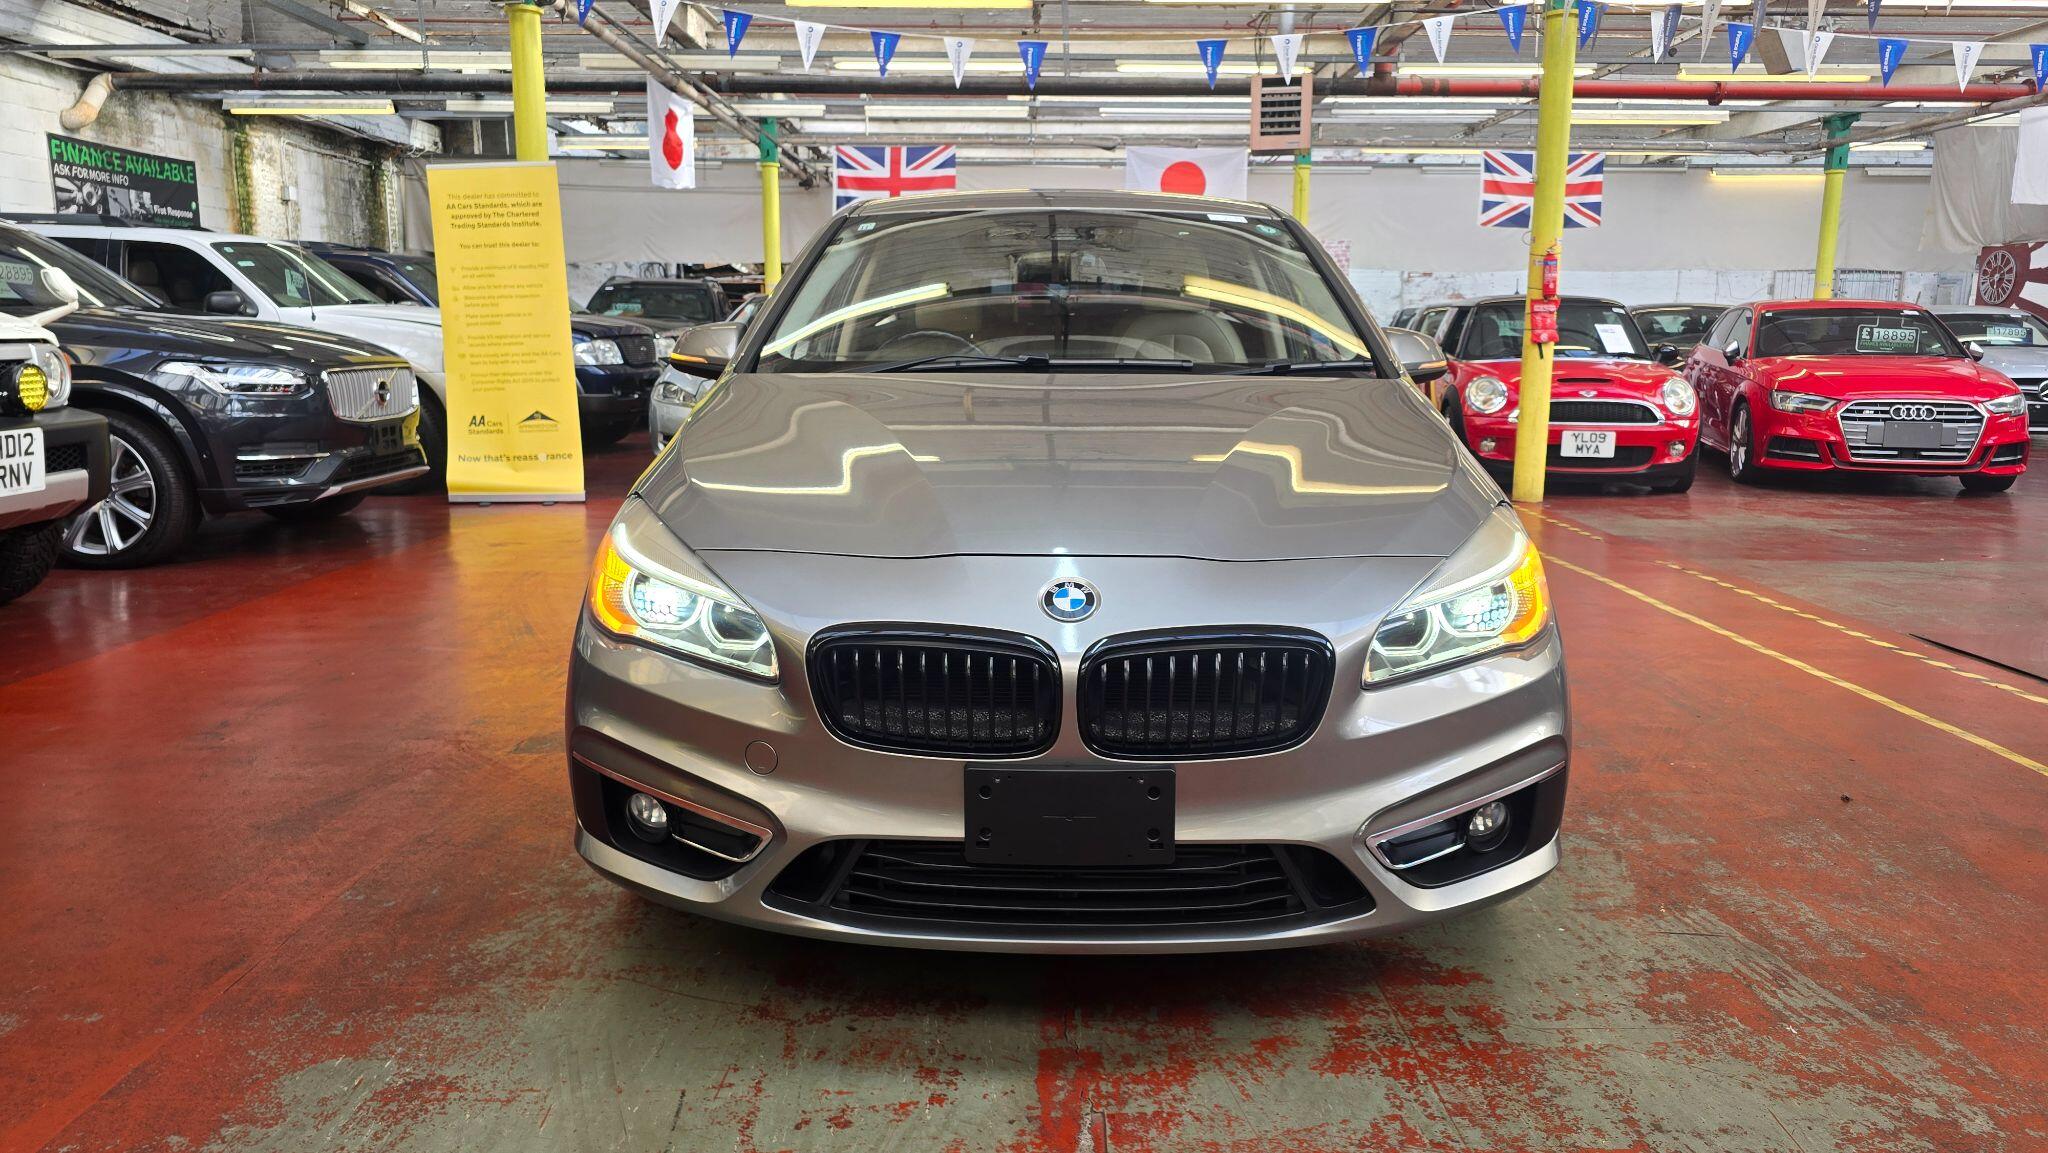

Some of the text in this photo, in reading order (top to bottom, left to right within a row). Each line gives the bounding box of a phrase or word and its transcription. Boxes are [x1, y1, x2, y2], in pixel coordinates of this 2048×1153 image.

[50, 139, 195, 184] FINANCE AVAILABLE
[53, 162, 129, 187] ASK FOR MORE INFO
[474, 202, 510, 210] Standards,
[451, 212, 482, 220] approved
[484, 212, 492, 220] by
[451, 222, 476, 230] Trading
[468, 416, 486, 427] AA
[1572, 432, 1606, 443] YL09
[0, 432, 34, 459] D12
[1576, 444, 1600, 456] MYA
[484, 454, 511, 462] that's
[512, 452, 573, 462] reassrance
[0, 461, 32, 489] RNV
